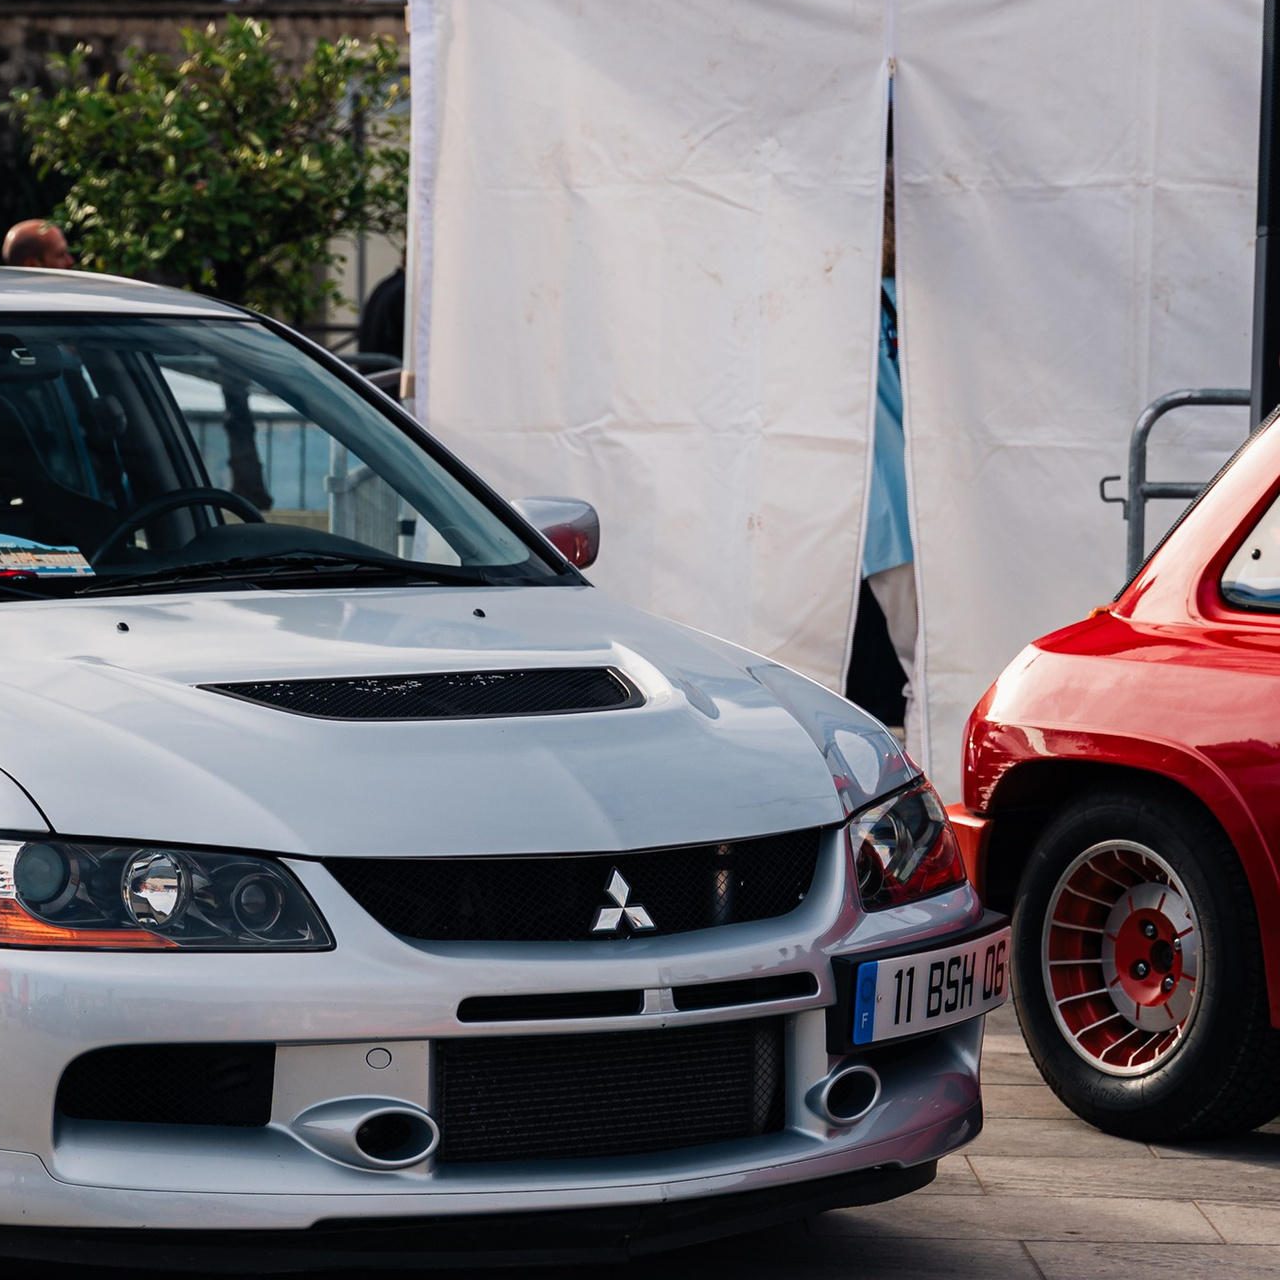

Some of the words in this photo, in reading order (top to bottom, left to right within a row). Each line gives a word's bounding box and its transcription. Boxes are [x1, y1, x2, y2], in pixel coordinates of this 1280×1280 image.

[894, 966, 916, 1025] 11
[926, 951, 977, 1019] BSH
[982, 939, 1007, 1001] 06
[860, 1012, 869, 1029] F
